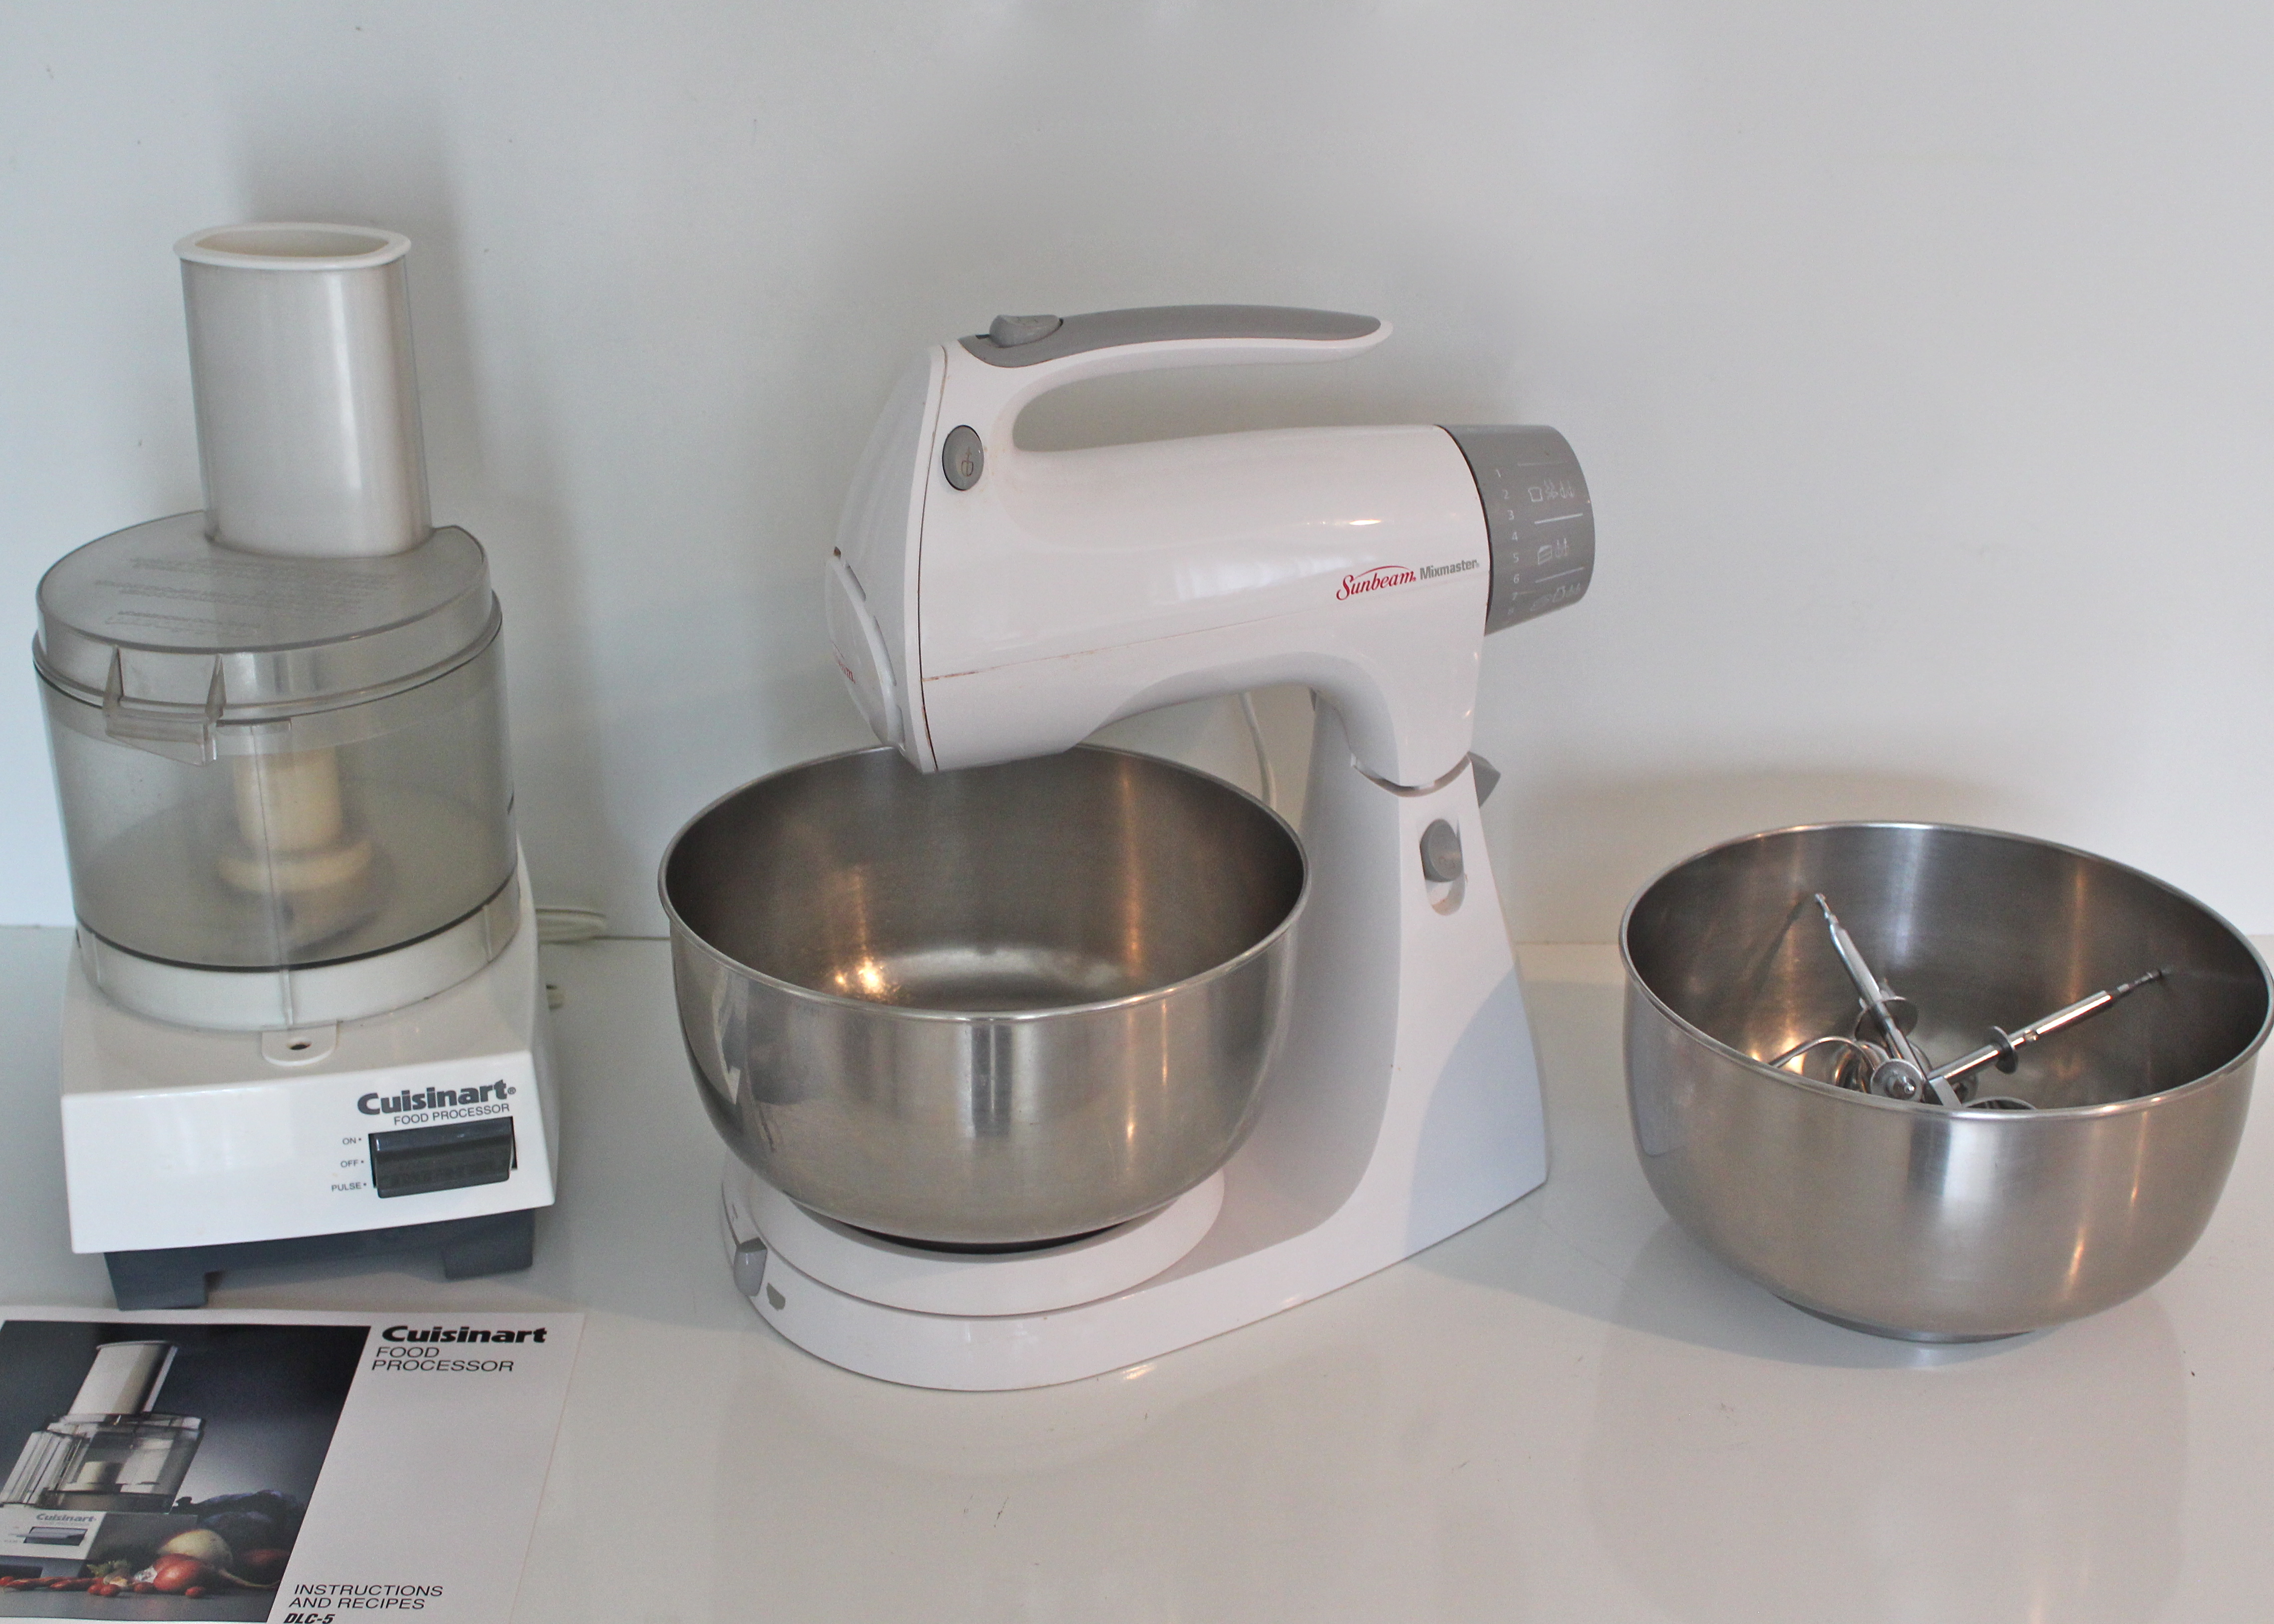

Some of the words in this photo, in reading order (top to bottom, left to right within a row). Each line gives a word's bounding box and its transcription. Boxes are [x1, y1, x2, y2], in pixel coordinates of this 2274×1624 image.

[1503, 489, 1509, 500] 2
[1508, 510, 1514, 520] 3
[1512, 532, 1518, 541] 4
[1513, 553, 1519, 563] 5
[1336, 565, 1417, 600] Sunbeam
[1420, 559, 1480, 580] Mixmaster
[1514, 574, 1520, 583] 6
[394, 1113, 429, 1125] FOOD
[433, 1103, 510, 1121] PROCESSOR
[331, 1182, 361, 1191] PULSE
[382, 1326, 547, 1343] Cuisinart
[376, 1347, 439, 1358] FOOD
[372, 1359, 514, 1371] PROCESSOR
[294, 1584, 443, 1597] INSTRUCTIONS
[289, 1597, 331, 1608] AND
[337, 1598, 425, 1610] RECIPES
[283, 1613, 335, 1624] DLC-5
